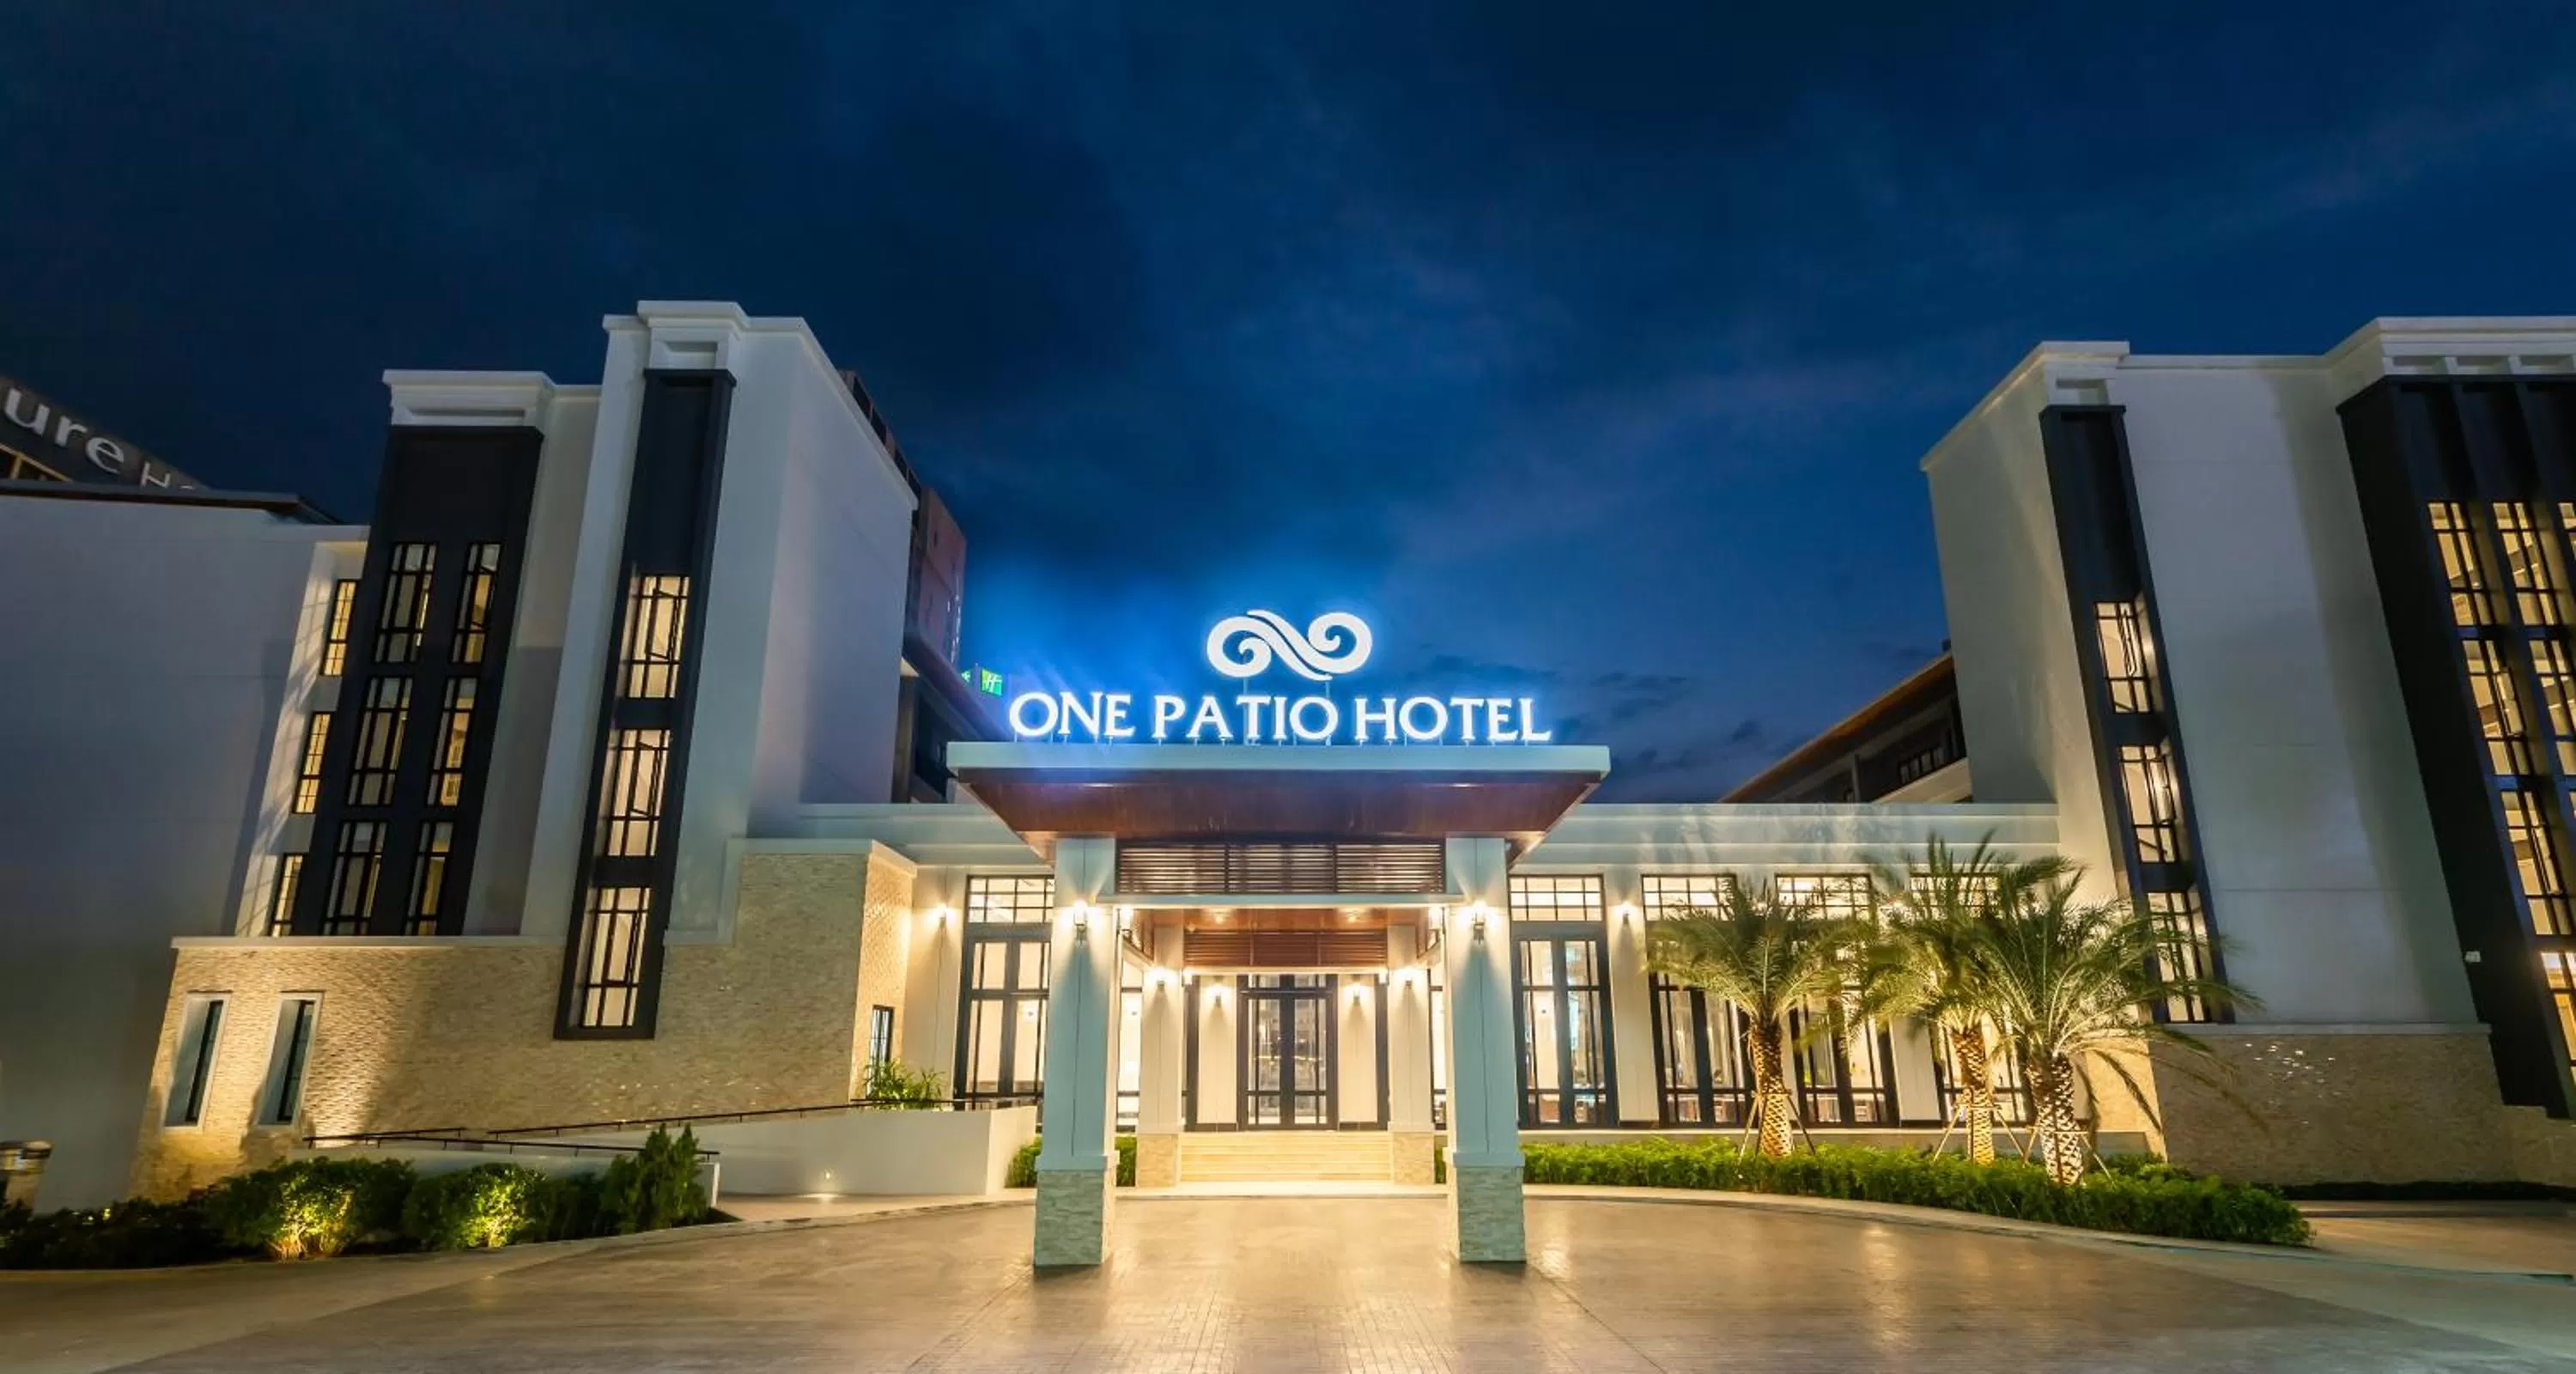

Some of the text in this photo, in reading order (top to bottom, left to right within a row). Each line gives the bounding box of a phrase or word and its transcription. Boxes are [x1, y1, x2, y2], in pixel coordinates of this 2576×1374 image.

[1009, 691, 1552, 743] ONE PATIO HOTEL
